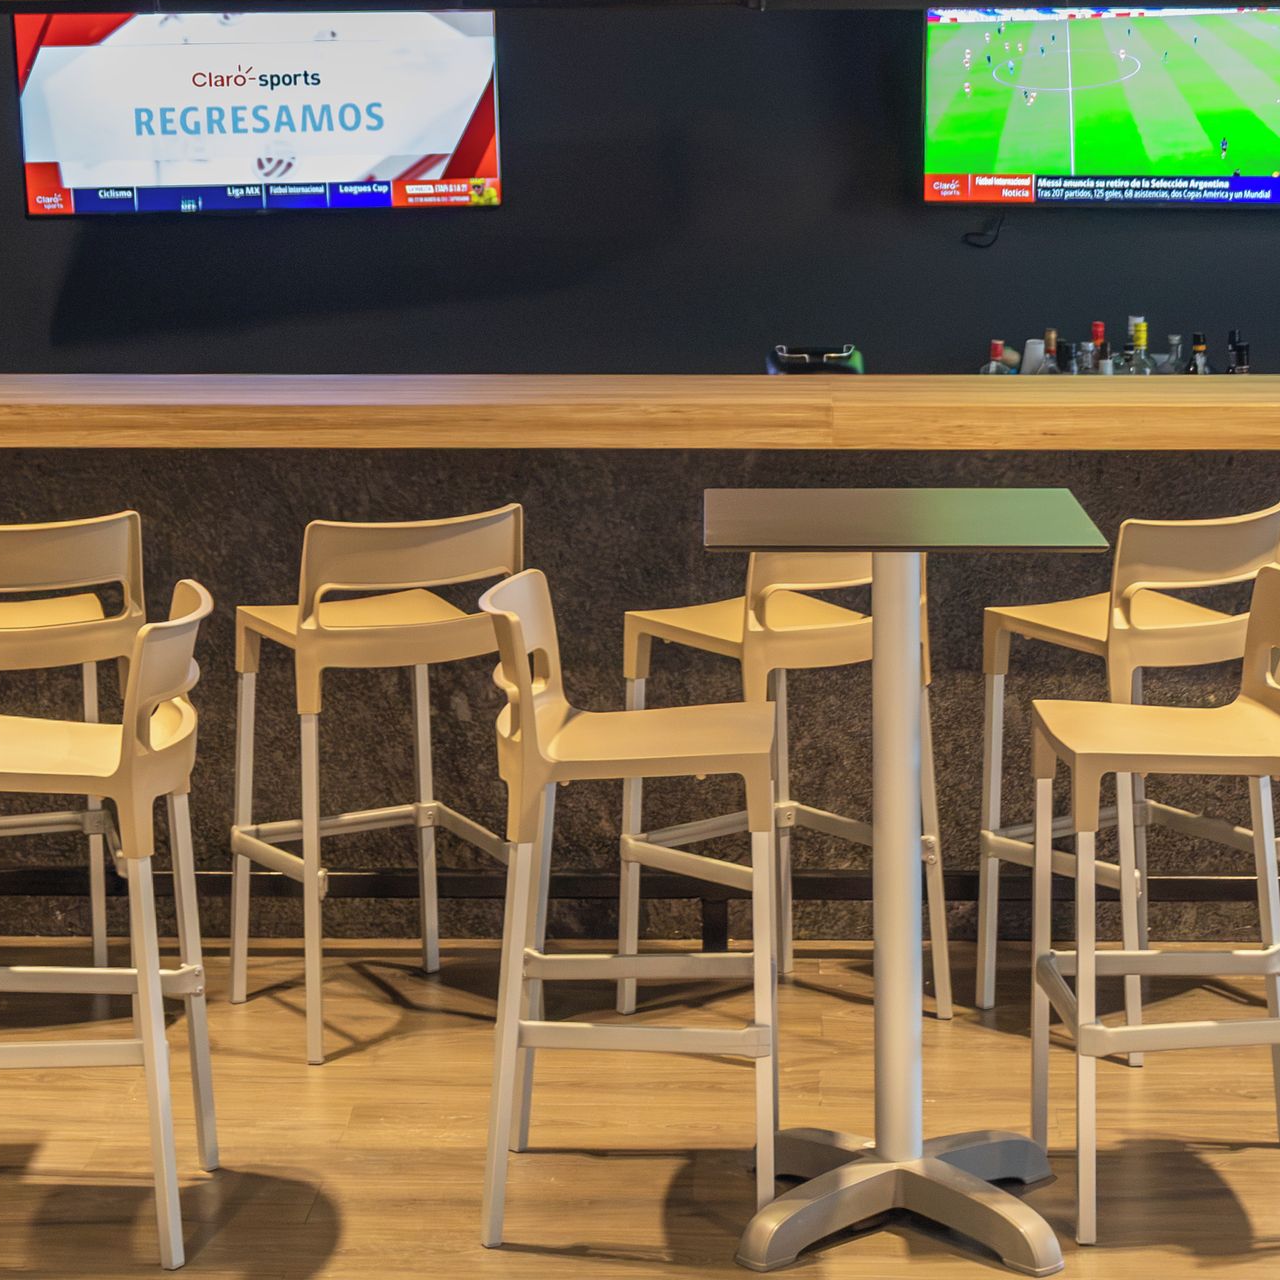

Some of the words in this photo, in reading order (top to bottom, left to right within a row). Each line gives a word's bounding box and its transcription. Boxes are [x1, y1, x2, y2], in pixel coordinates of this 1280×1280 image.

[192, 68, 249, 87] Claro
[258, 70, 321, 90] sports
[134, 102, 385, 136] REGRESAMOS
[933, 180, 957, 190] Claro
[1038, 177, 1062, 187] Messi
[1063, 178, 1094, 188] anuncia
[1095, 180, 1105, 188] su
[1130, 178, 1140, 188] de
[1189, 179, 1230, 190] Argentina
[1001, 188, 1030, 198] Noticia
[1037, 189, 1051, 198] Tras
